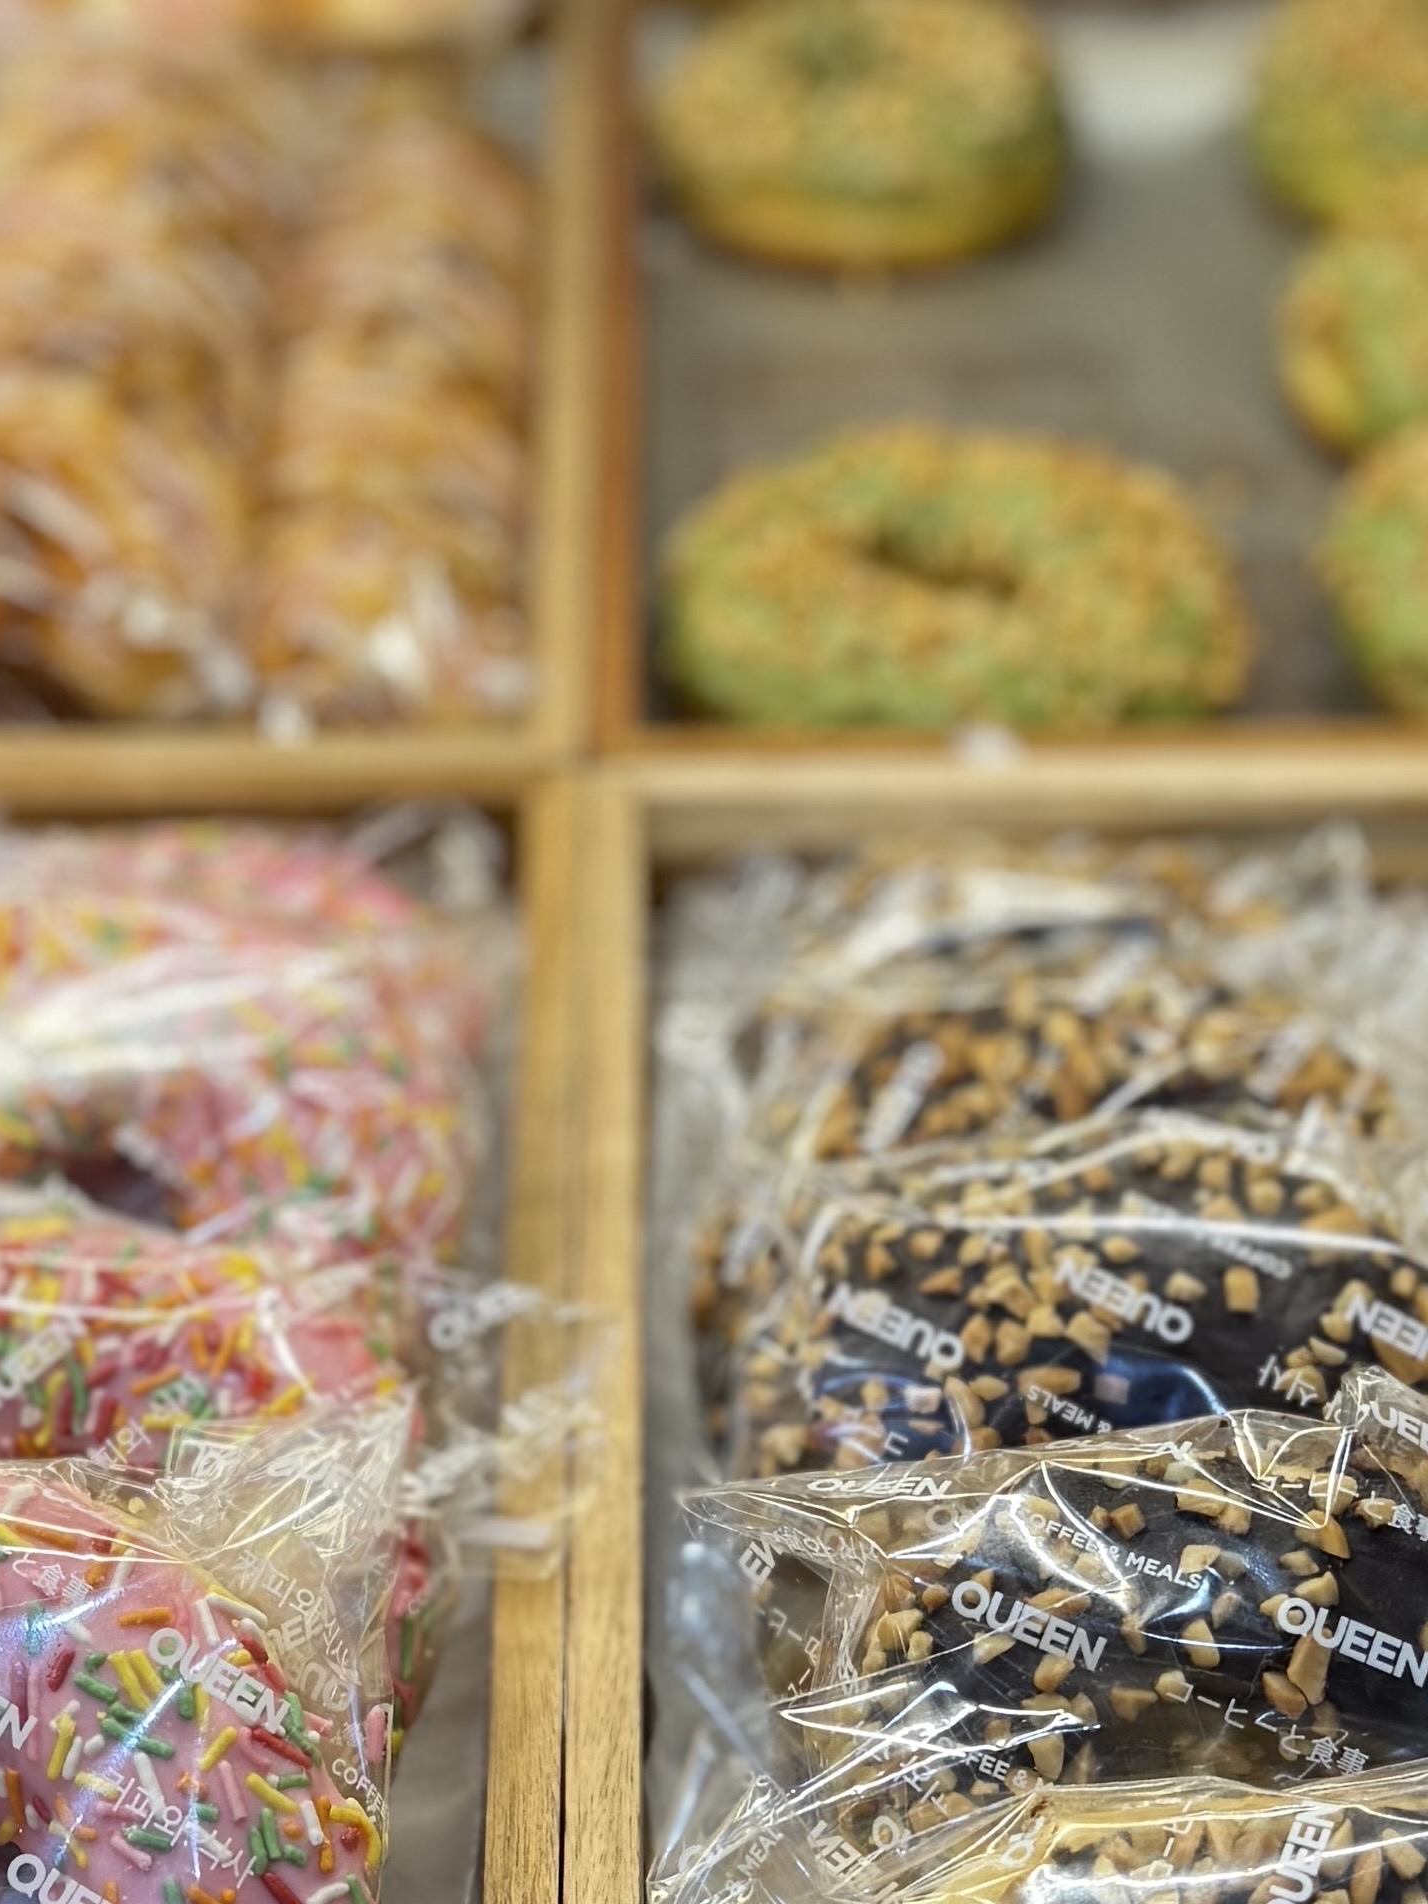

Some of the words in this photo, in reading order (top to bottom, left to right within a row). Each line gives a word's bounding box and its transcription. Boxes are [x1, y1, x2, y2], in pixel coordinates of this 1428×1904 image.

[827, 1282, 964, 1372] QUEEN
[1053, 1256, 1194, 1343] QUEEN
[1026, 1385, 1099, 1429] MEALS
[1126, 1552, 1203, 1590] MEALS
[951, 1580, 1107, 1672] QUEEN
[148, 1628, 290, 1734] QUEEN
[105, 1770, 193, 1846] 커피와
[197, 1830, 257, 1889] 식사
